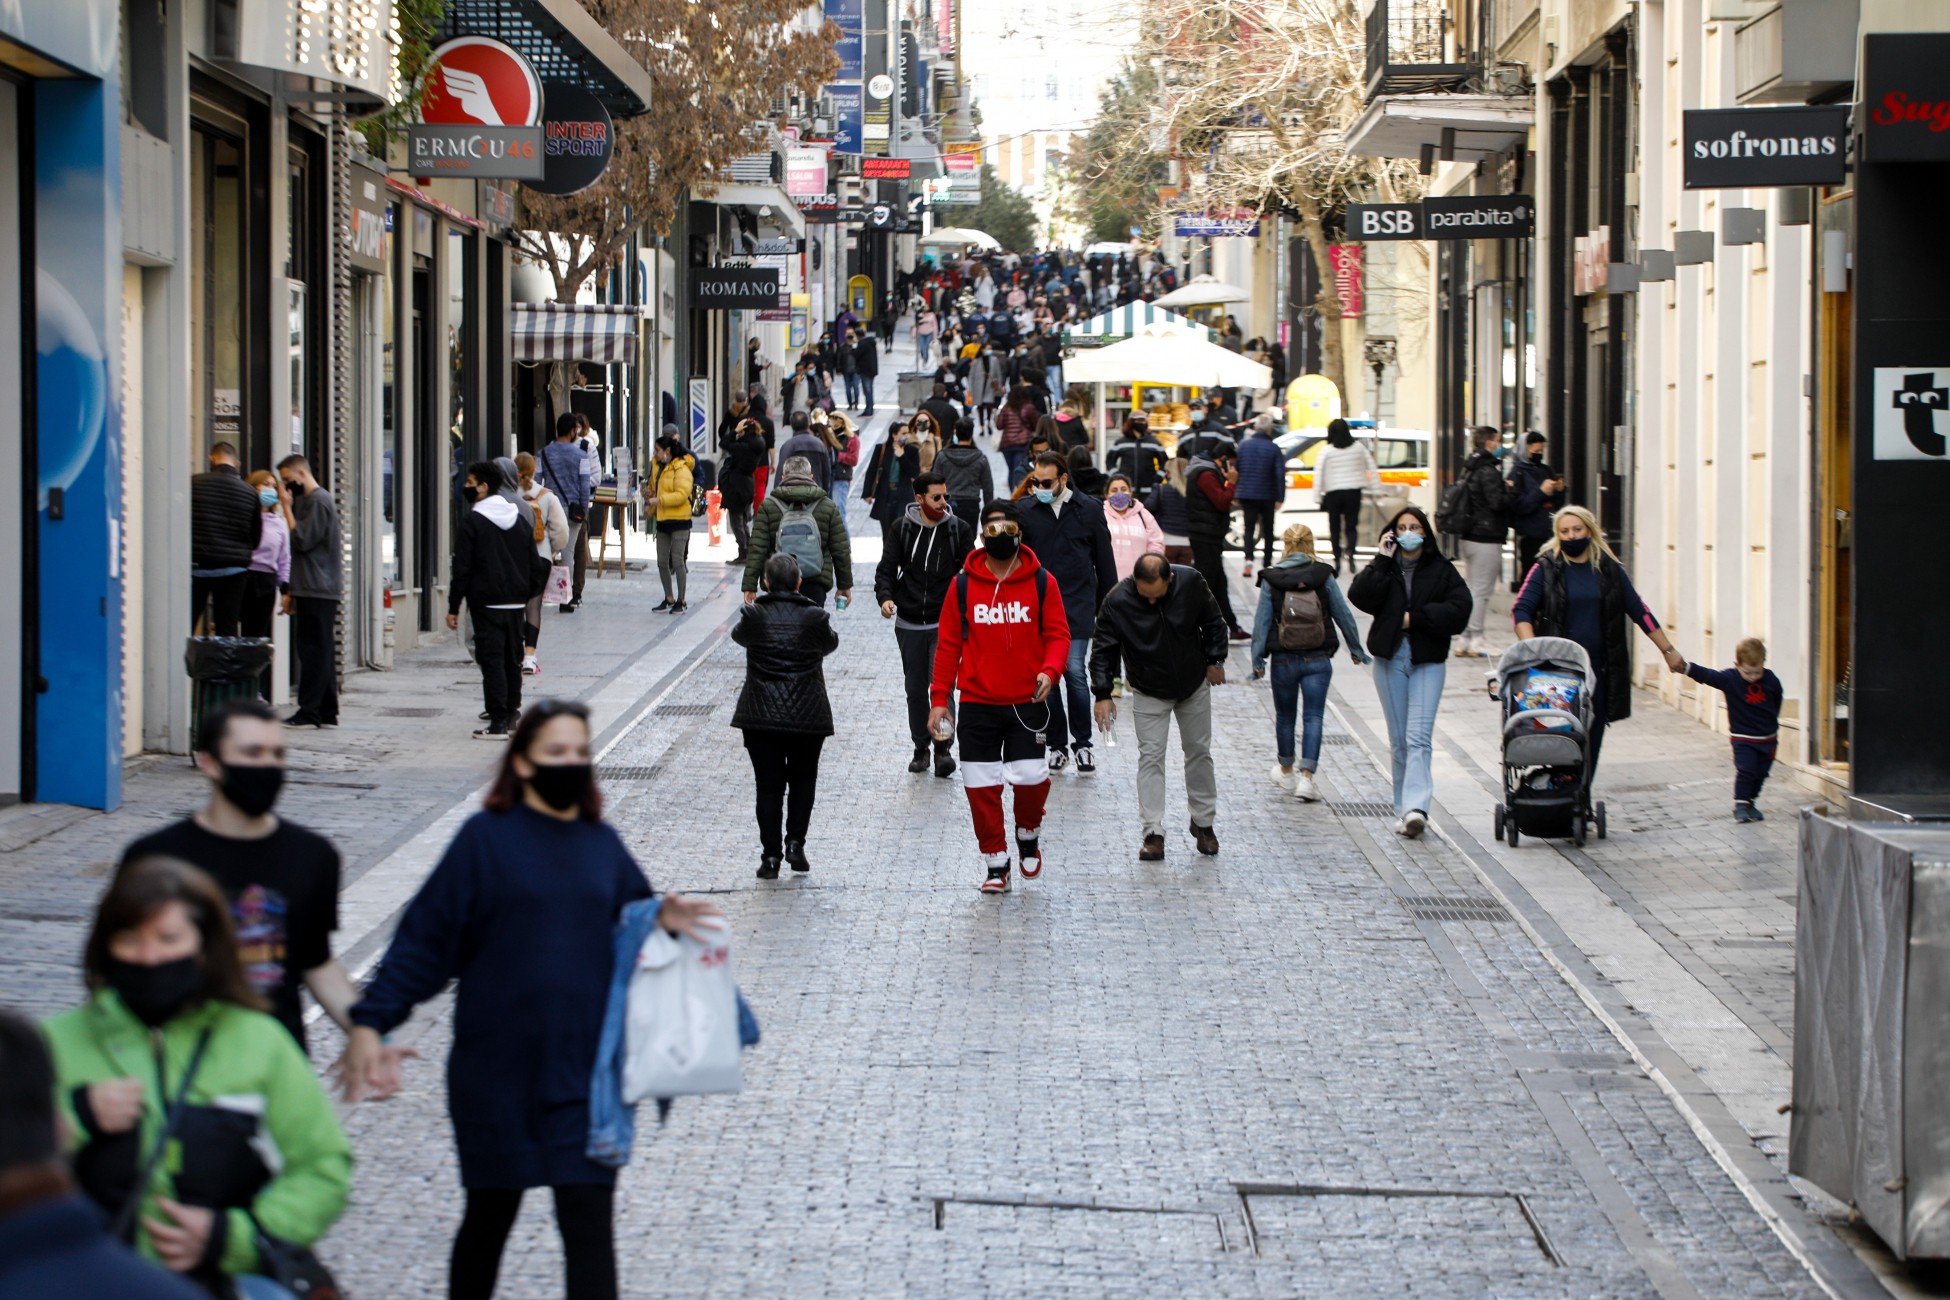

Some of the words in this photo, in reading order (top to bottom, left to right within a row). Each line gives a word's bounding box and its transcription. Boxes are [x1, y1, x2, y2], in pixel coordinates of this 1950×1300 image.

[546, 121, 606, 139] INTER
[545, 138, 607, 157] SPORT
[1693, 130, 1837, 159] sofronas
[1362, 210, 1415, 235] BSB
[1431, 208, 1514, 230] parabita
[700, 281, 777, 296] ROMANO
